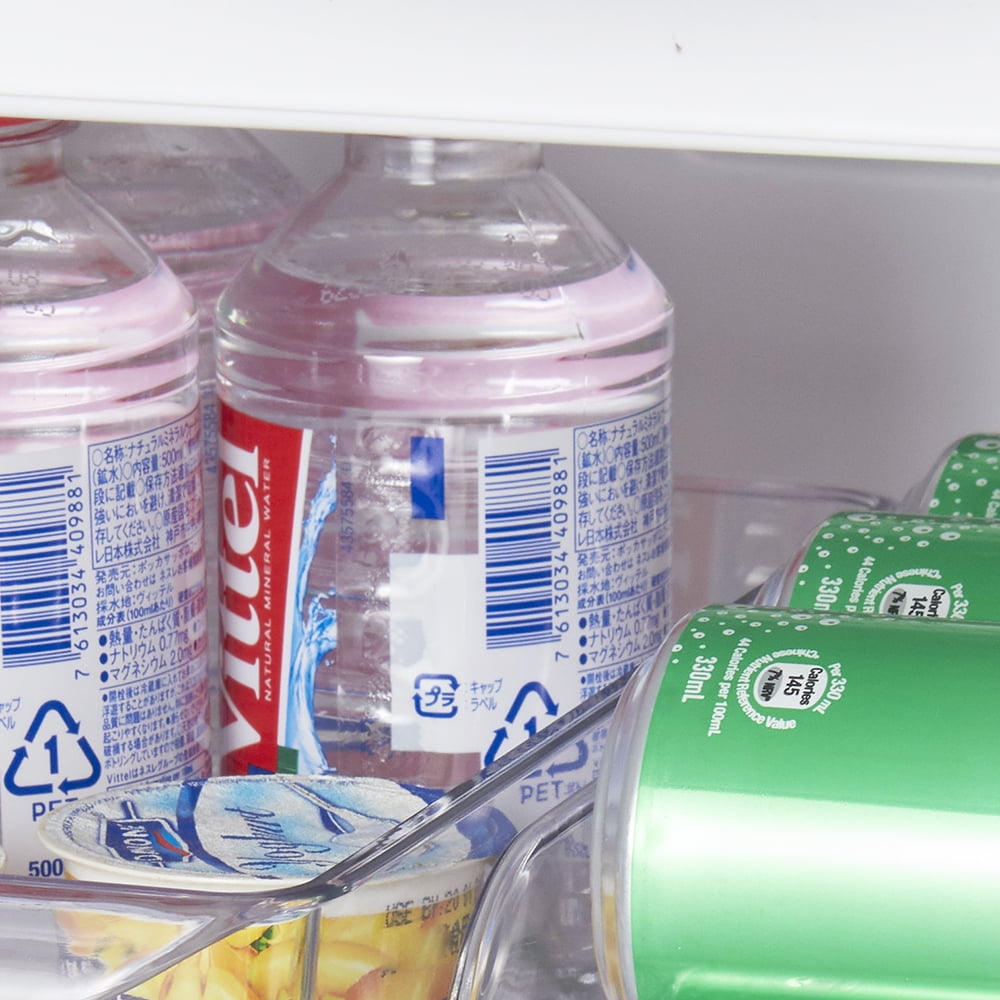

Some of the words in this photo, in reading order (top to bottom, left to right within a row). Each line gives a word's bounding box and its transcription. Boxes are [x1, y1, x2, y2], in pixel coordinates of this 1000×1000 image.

[264, 457, 272, 521] WATER
[553, 456, 569, 538] 409881
[67, 474, 84, 555] 409881
[264, 530, 272, 609] MINERAL
[553, 551, 569, 633] 613034
[71, 568, 89, 650] 613034
[110, 640, 156, 664] ナトリウム
[264, 617, 272, 702] NATURAL
[723, 647, 747, 681] Calories
[75, 669, 89, 680] 7
[110, 656, 167, 680] マグネシウム
[681, 656, 717, 703] 330mL
[828, 662, 842, 677] Per
[424, 686, 455, 706] プラ
[718, 682, 731, 699] per
[783, 674, 803, 696] 145
[800, 667, 823, 706] Calories
[826, 677, 847, 701] 330
[707, 702, 728, 737] 100mL
[812, 700, 832, 715] mL
[765, 716, 797, 730] Value
[44, 735, 59, 774] 1
[520, 780, 563, 804] PET
[29, 859, 64, 877] 500
